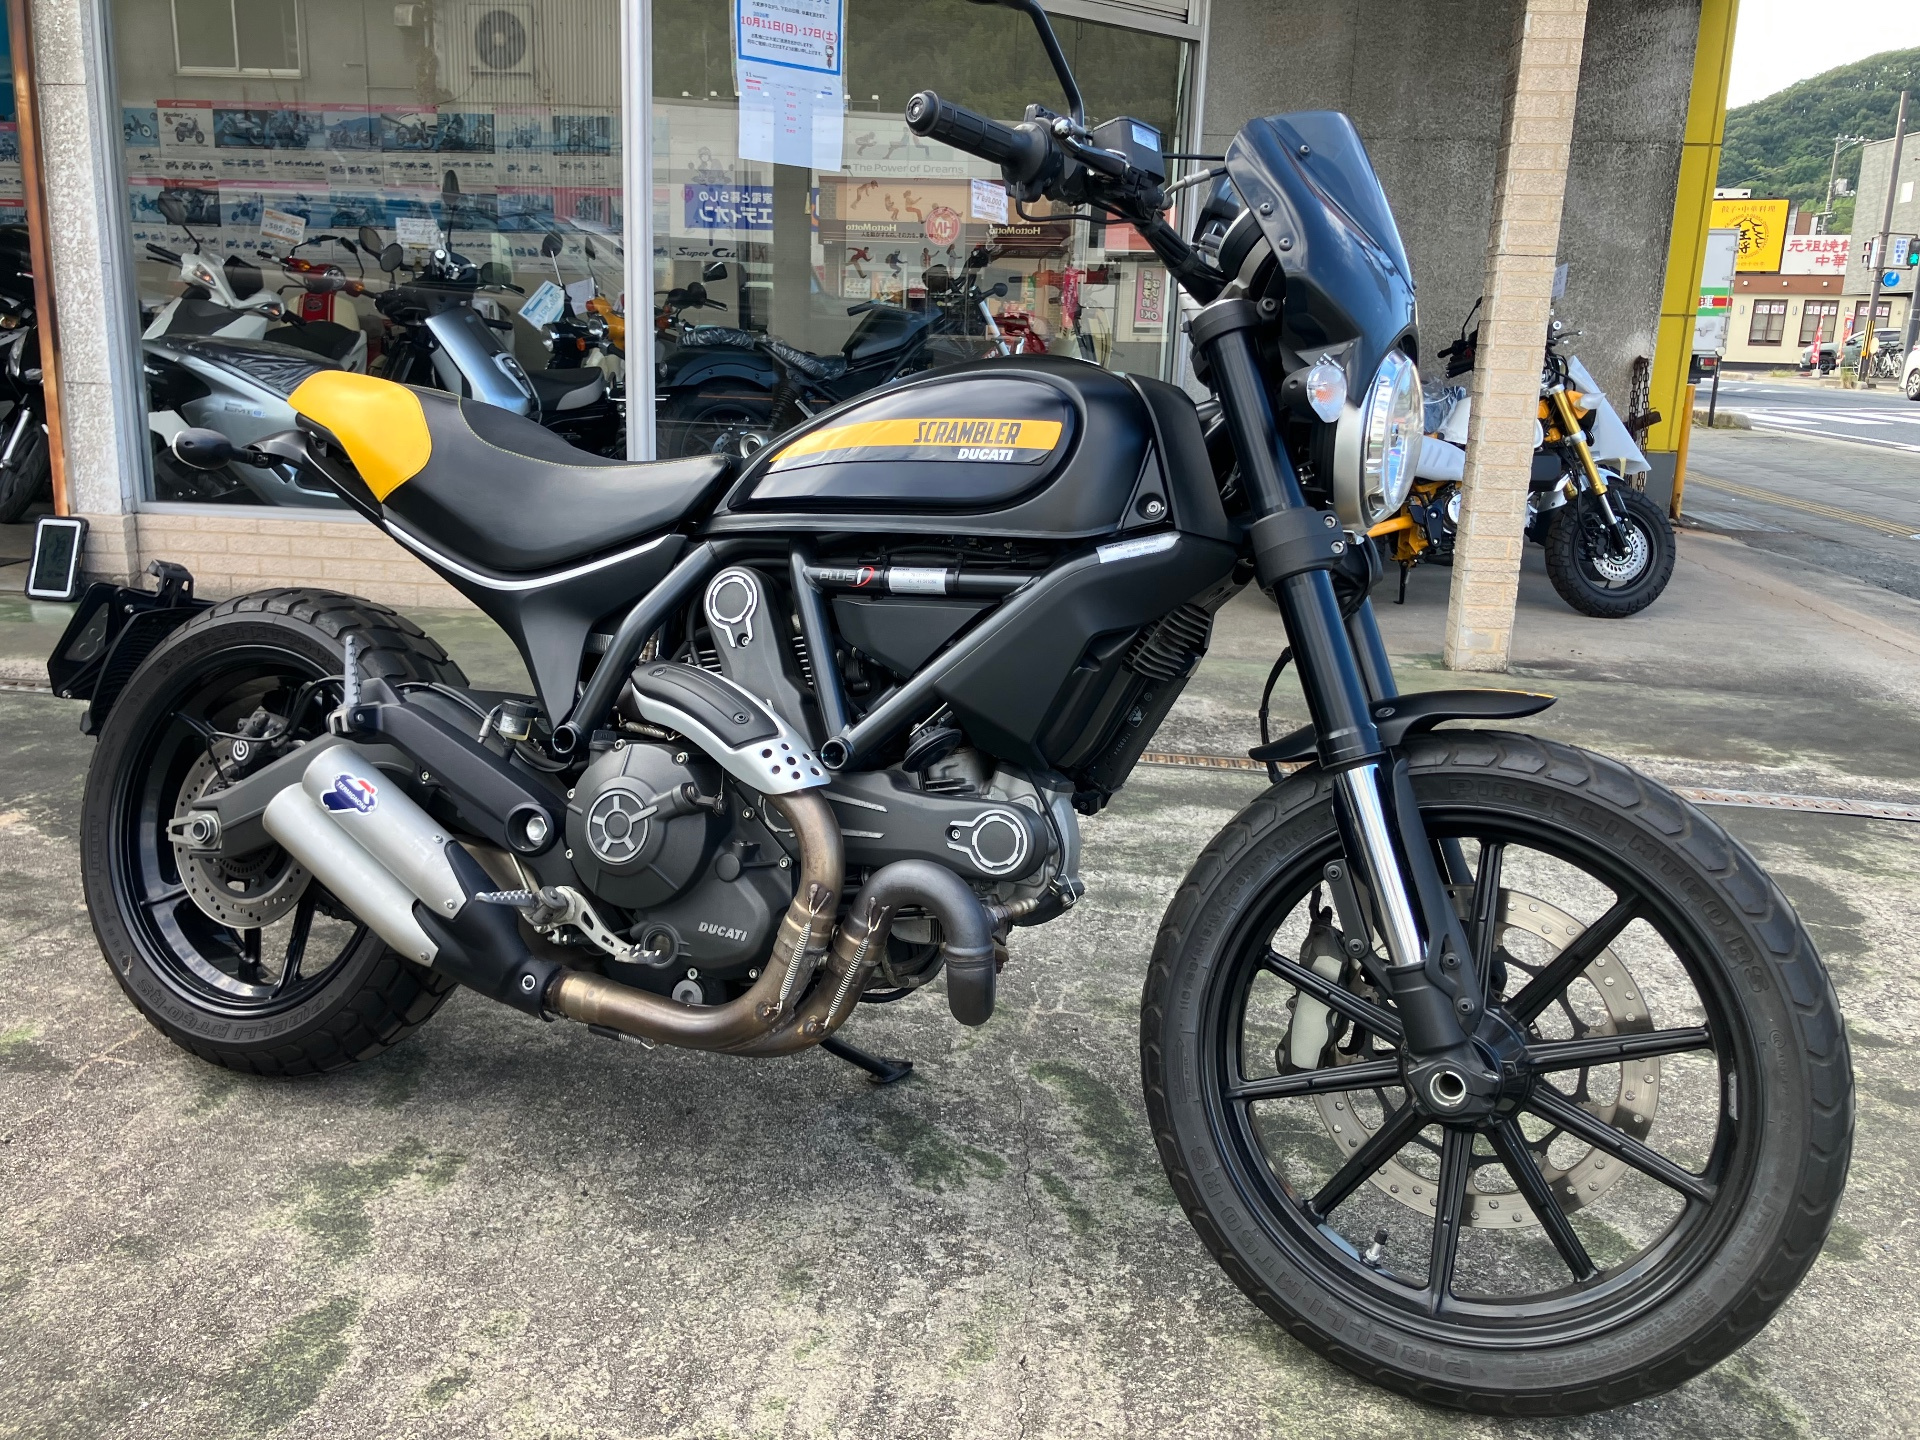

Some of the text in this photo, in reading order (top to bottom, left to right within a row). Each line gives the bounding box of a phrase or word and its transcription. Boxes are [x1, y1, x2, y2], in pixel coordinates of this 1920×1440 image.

[853, 163, 964, 174] The Power of Dreams
[676, 247, 737, 258] Super Cu
[1699, 295, 1715, 309] 運
[913, 421, 1021, 445] SCRAMBLER
[957, 448, 1014, 461] DUCATI
[337, 780, 367, 811] TERMIGNONI
[1448, 778, 1622, 837] PIRELLI
[698, 921, 748, 942] DUCATI
[1308, 1298, 1472, 1379] PIRELLI
